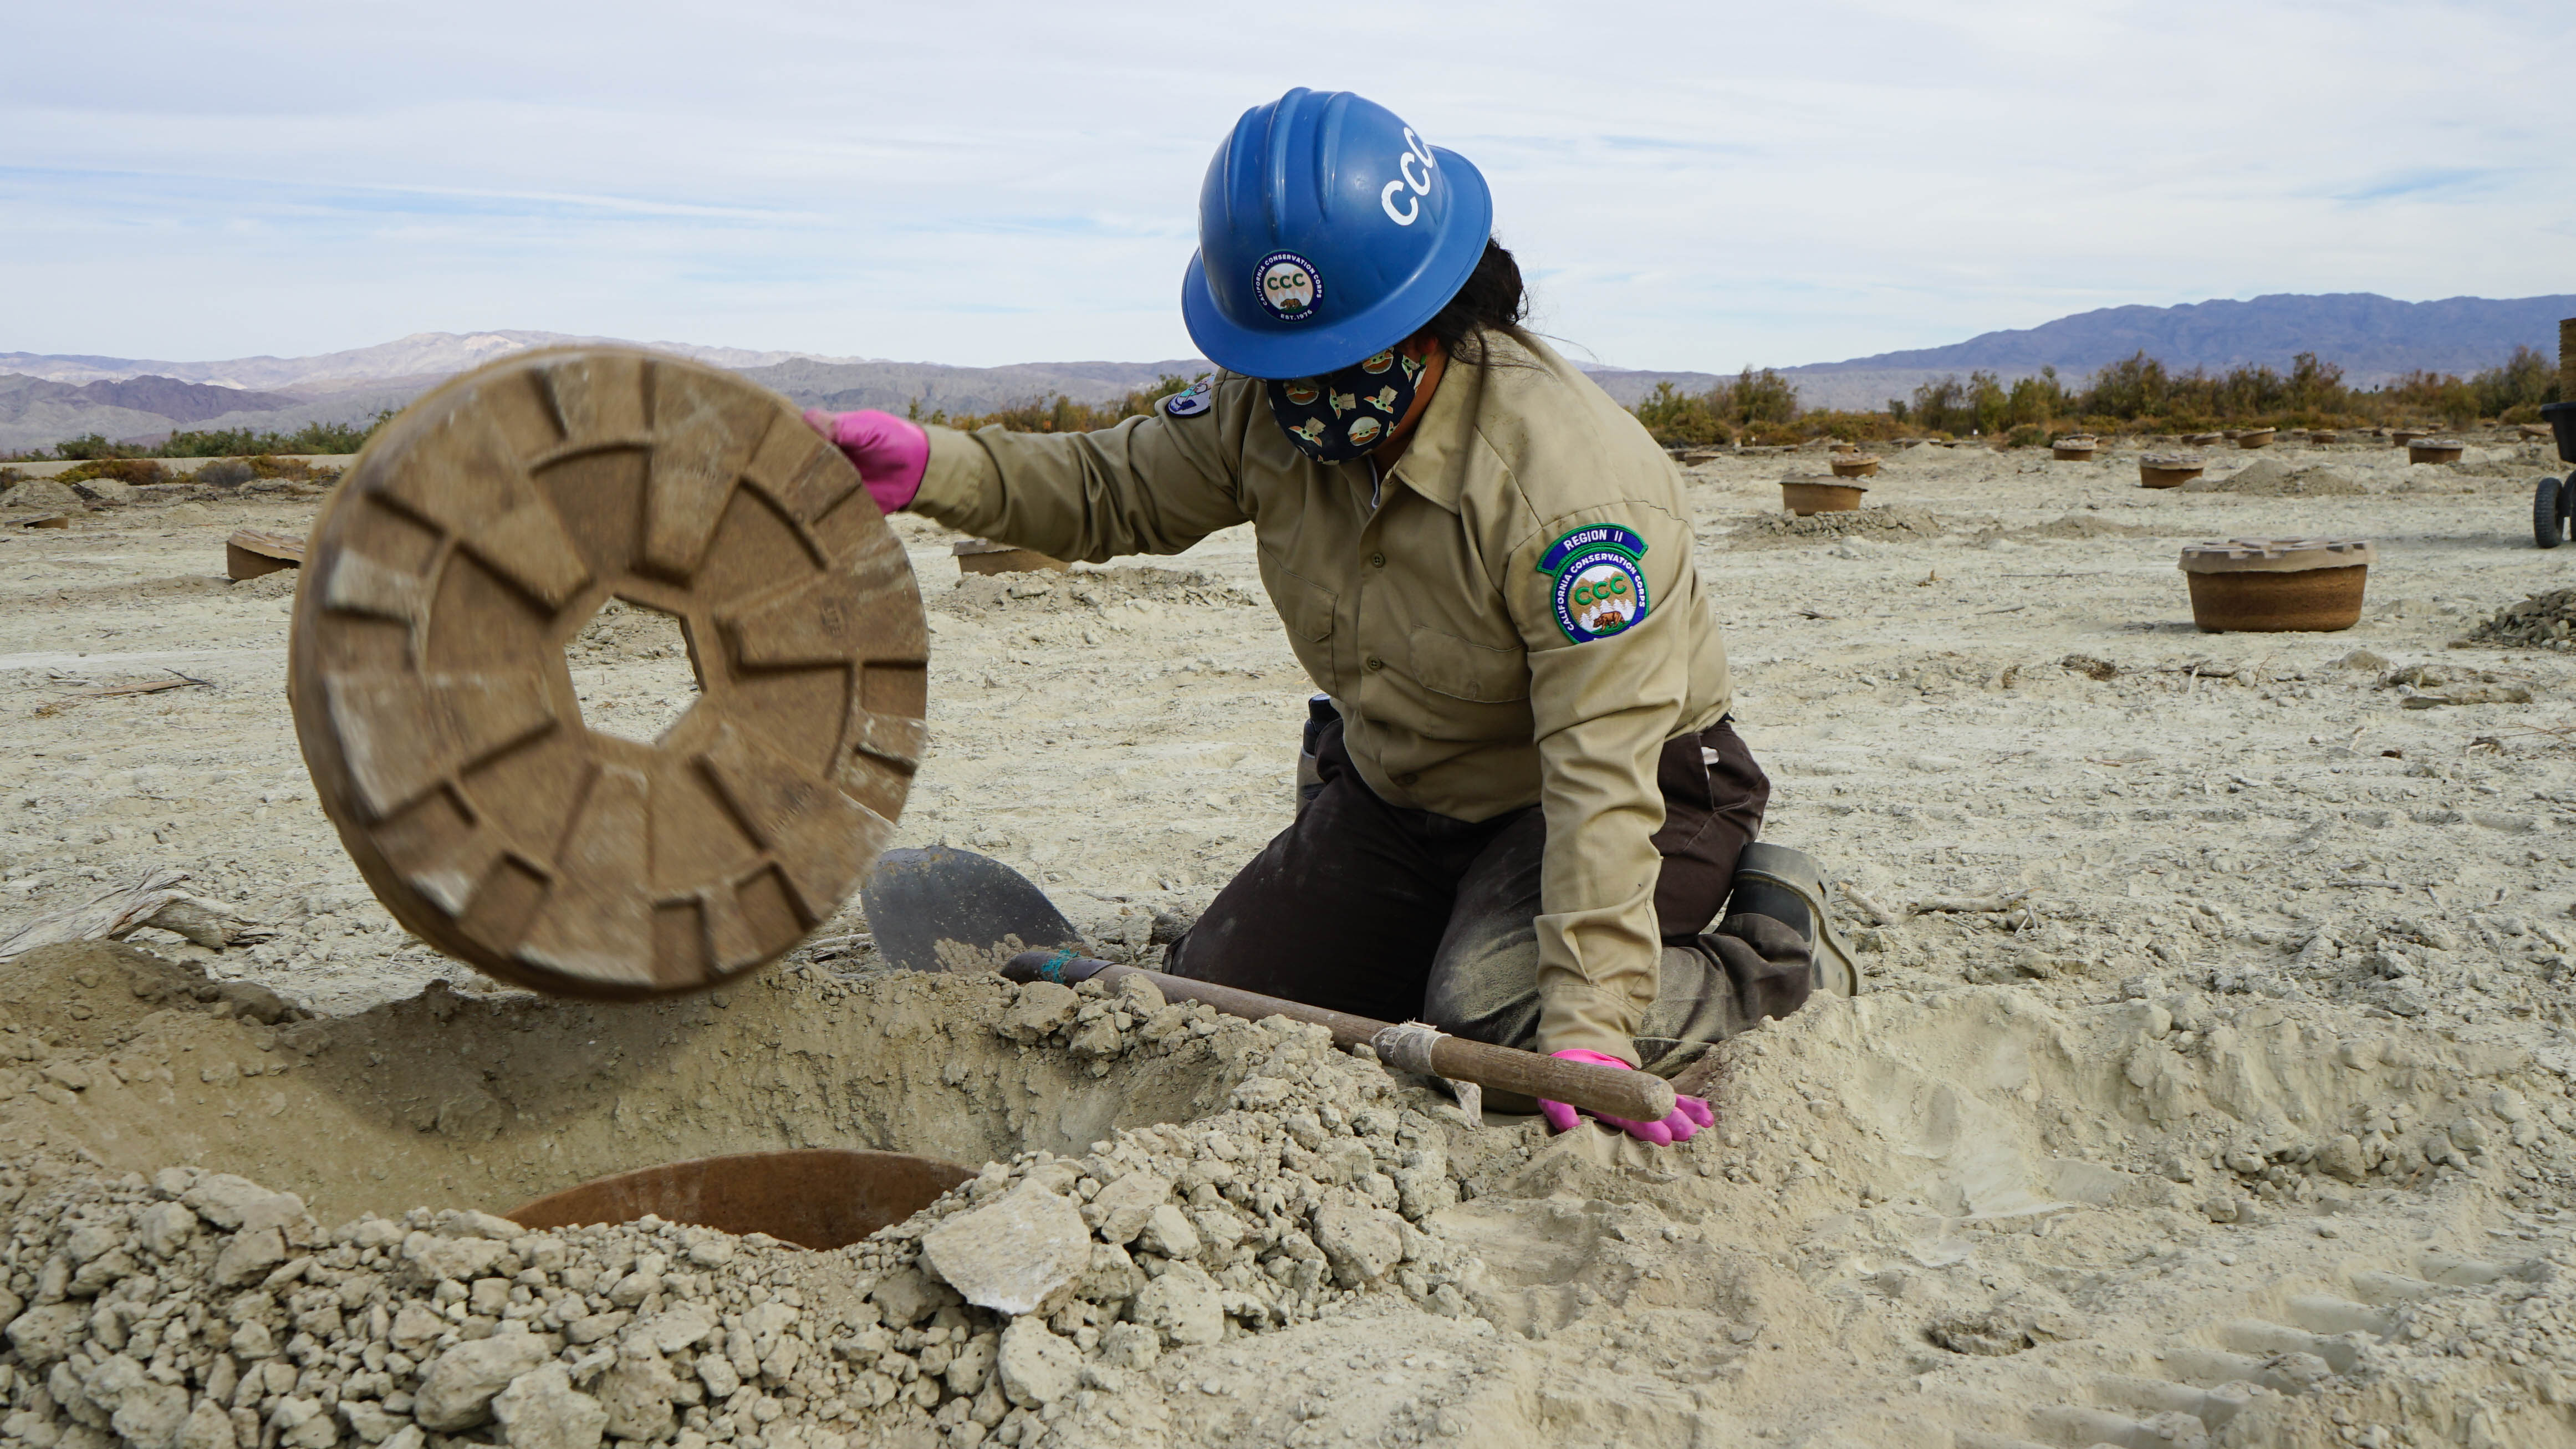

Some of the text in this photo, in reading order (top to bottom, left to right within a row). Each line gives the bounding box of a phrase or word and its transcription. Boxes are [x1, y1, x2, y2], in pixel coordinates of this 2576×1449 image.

[1381, 127, 1433, 226] CCC
[1256, 254, 1322, 305] CALIFORNIA CONSERVATION CORPS
[1267, 273, 1305, 290] CCC
[1563, 529, 1623, 551] REGION II
[1557, 553, 1645, 631] CALIFORNIA CONSERVATION CORPS
[1574, 576, 1627, 605] CCC
